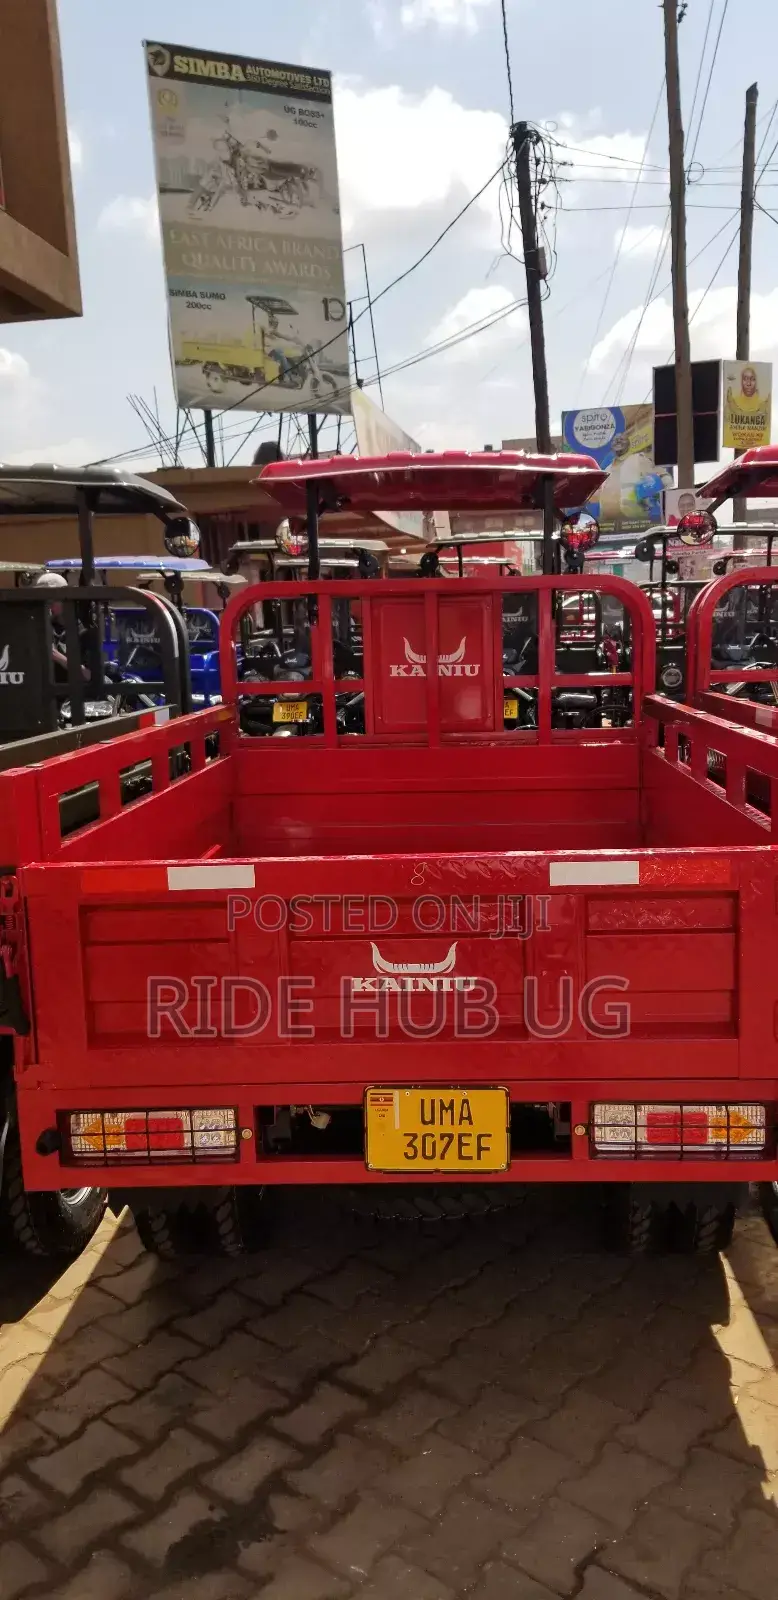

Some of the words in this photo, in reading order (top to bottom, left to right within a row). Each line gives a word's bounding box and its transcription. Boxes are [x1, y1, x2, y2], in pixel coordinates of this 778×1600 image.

[174, 55, 246, 82] SIMBA
[246, 65, 311, 84] AUTOMOTIVES
[313, 76, 330, 87] LTD
[284, 105, 296, 115] UG
[169, 229, 208, 248] EAST
[217, 235, 276, 254] AFRICA
[282, 240, 340, 260] BRAND
[181, 253, 257, 272] QUALITY
[263, 261, 332, 280] AWARDS
[169, 289, 198, 299] SIMBA
[200, 291, 226, 301] SUMO
[186, 301, 212, 310] 200cc
[730, 414, 766, 425] LUKANGA
[389, 664, 480, 677] KANIU
[351, 976, 478, 992] KAINIU
[420, 1098, 474, 1126] UMA
[403, 1132, 493, 1161] 307EF
